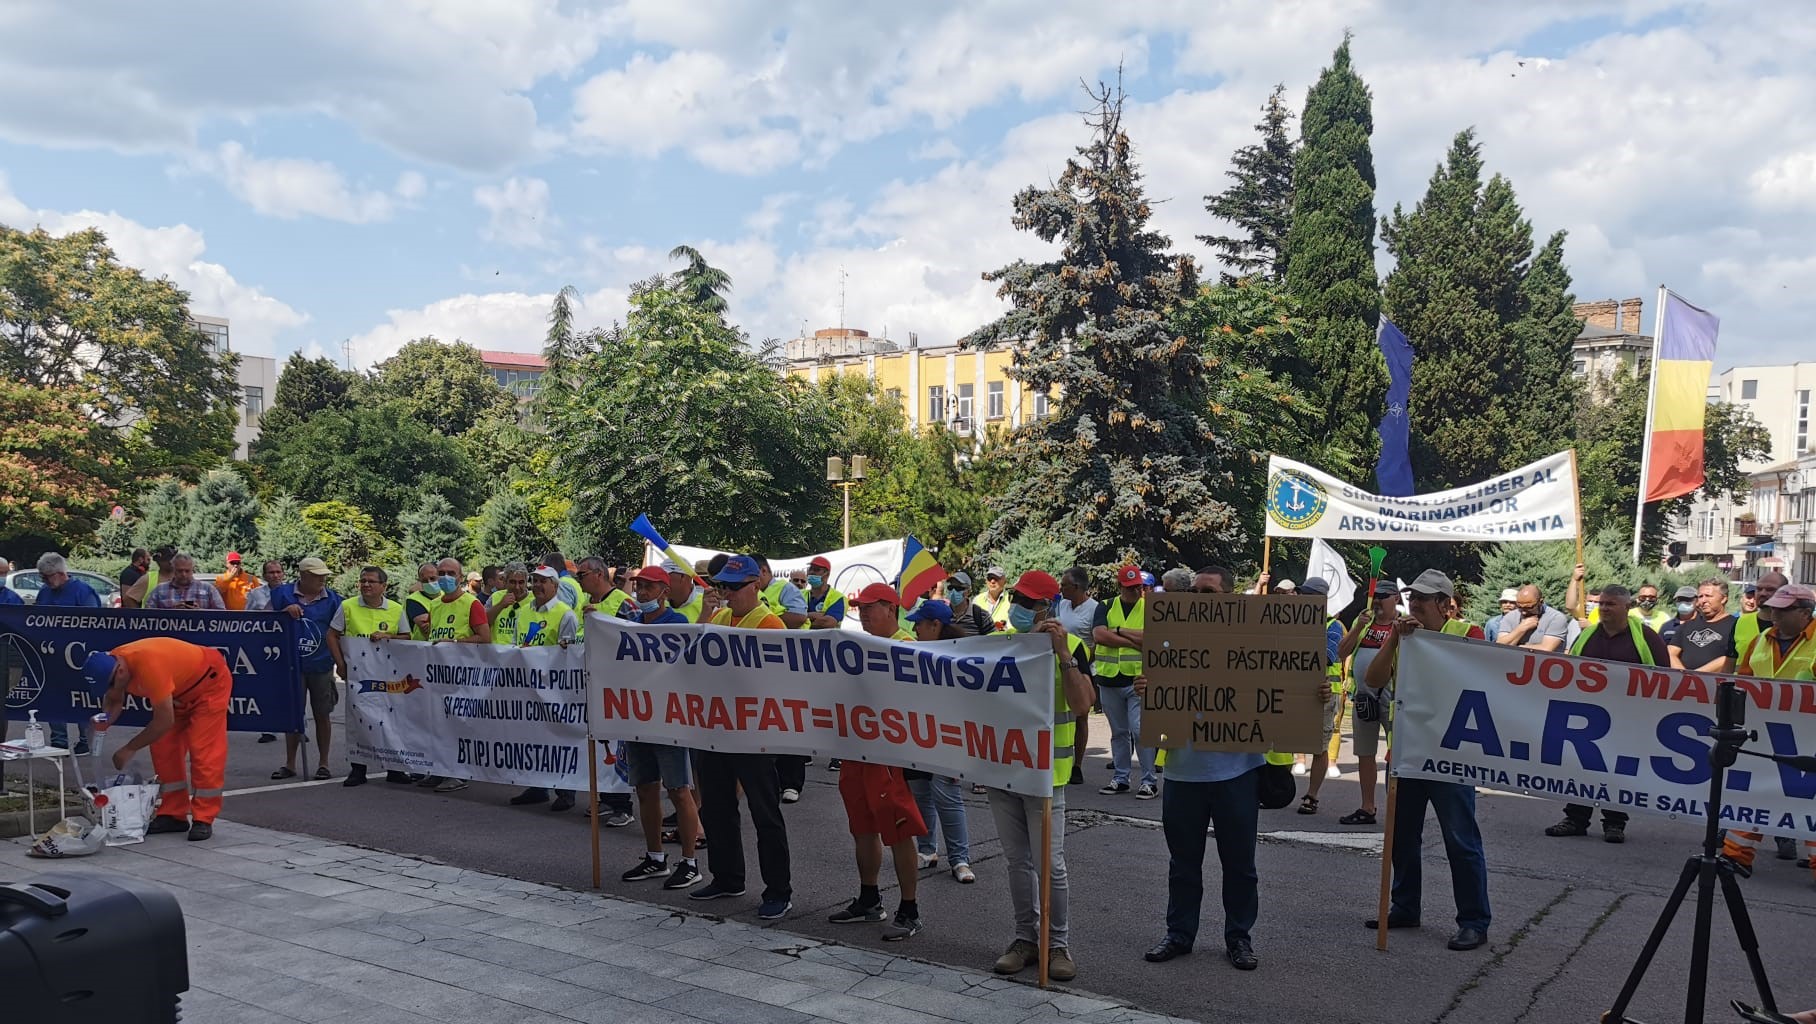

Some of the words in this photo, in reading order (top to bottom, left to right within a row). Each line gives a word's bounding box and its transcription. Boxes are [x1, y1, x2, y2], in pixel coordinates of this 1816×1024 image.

[1465, 475, 1525, 500] LIBER
[1531, 468, 1557, 485] AL
[1379, 496, 1518, 520] MARINARILOR
[1338, 515, 1419, 532] ARSVOM
[26, 614, 126, 630] CONFEDERATIA
[129, 617, 205, 632] NATIONALA
[209, 619, 283, 633] SINDICALA
[1260, 603, 1325, 625] ARSVOM
[616, 631, 1027, 693] ARSVOM=IMO=EMSA
[1148, 649, 1210, 669] DORESC
[1227, 646, 1321, 671] PĂSTRAREA
[426, 664, 480, 687] SINDICATUL
[530, 669, 546, 690] AL
[1506, 655, 1608, 693] JOS
[452, 697, 523, 720] PERSONALULUI
[1256, 689, 1285, 714] DE
[603, 688, 653, 721] NU
[665, 692, 1051, 770] ARAFAT=IGSU=MAI
[1192, 720, 1265, 743] MUNCĂ
[457, 738, 472, 765] BT
[473, 740, 490, 768] IPJ
[493, 741, 578, 780] CONSTANȚA
[1421, 758, 1510, 785] AGENȚIA
[1517, 773, 1611, 802] ROMÂNĂ
[1618, 789, 1649, 808] DE
[1777, 812, 1795, 830] A
